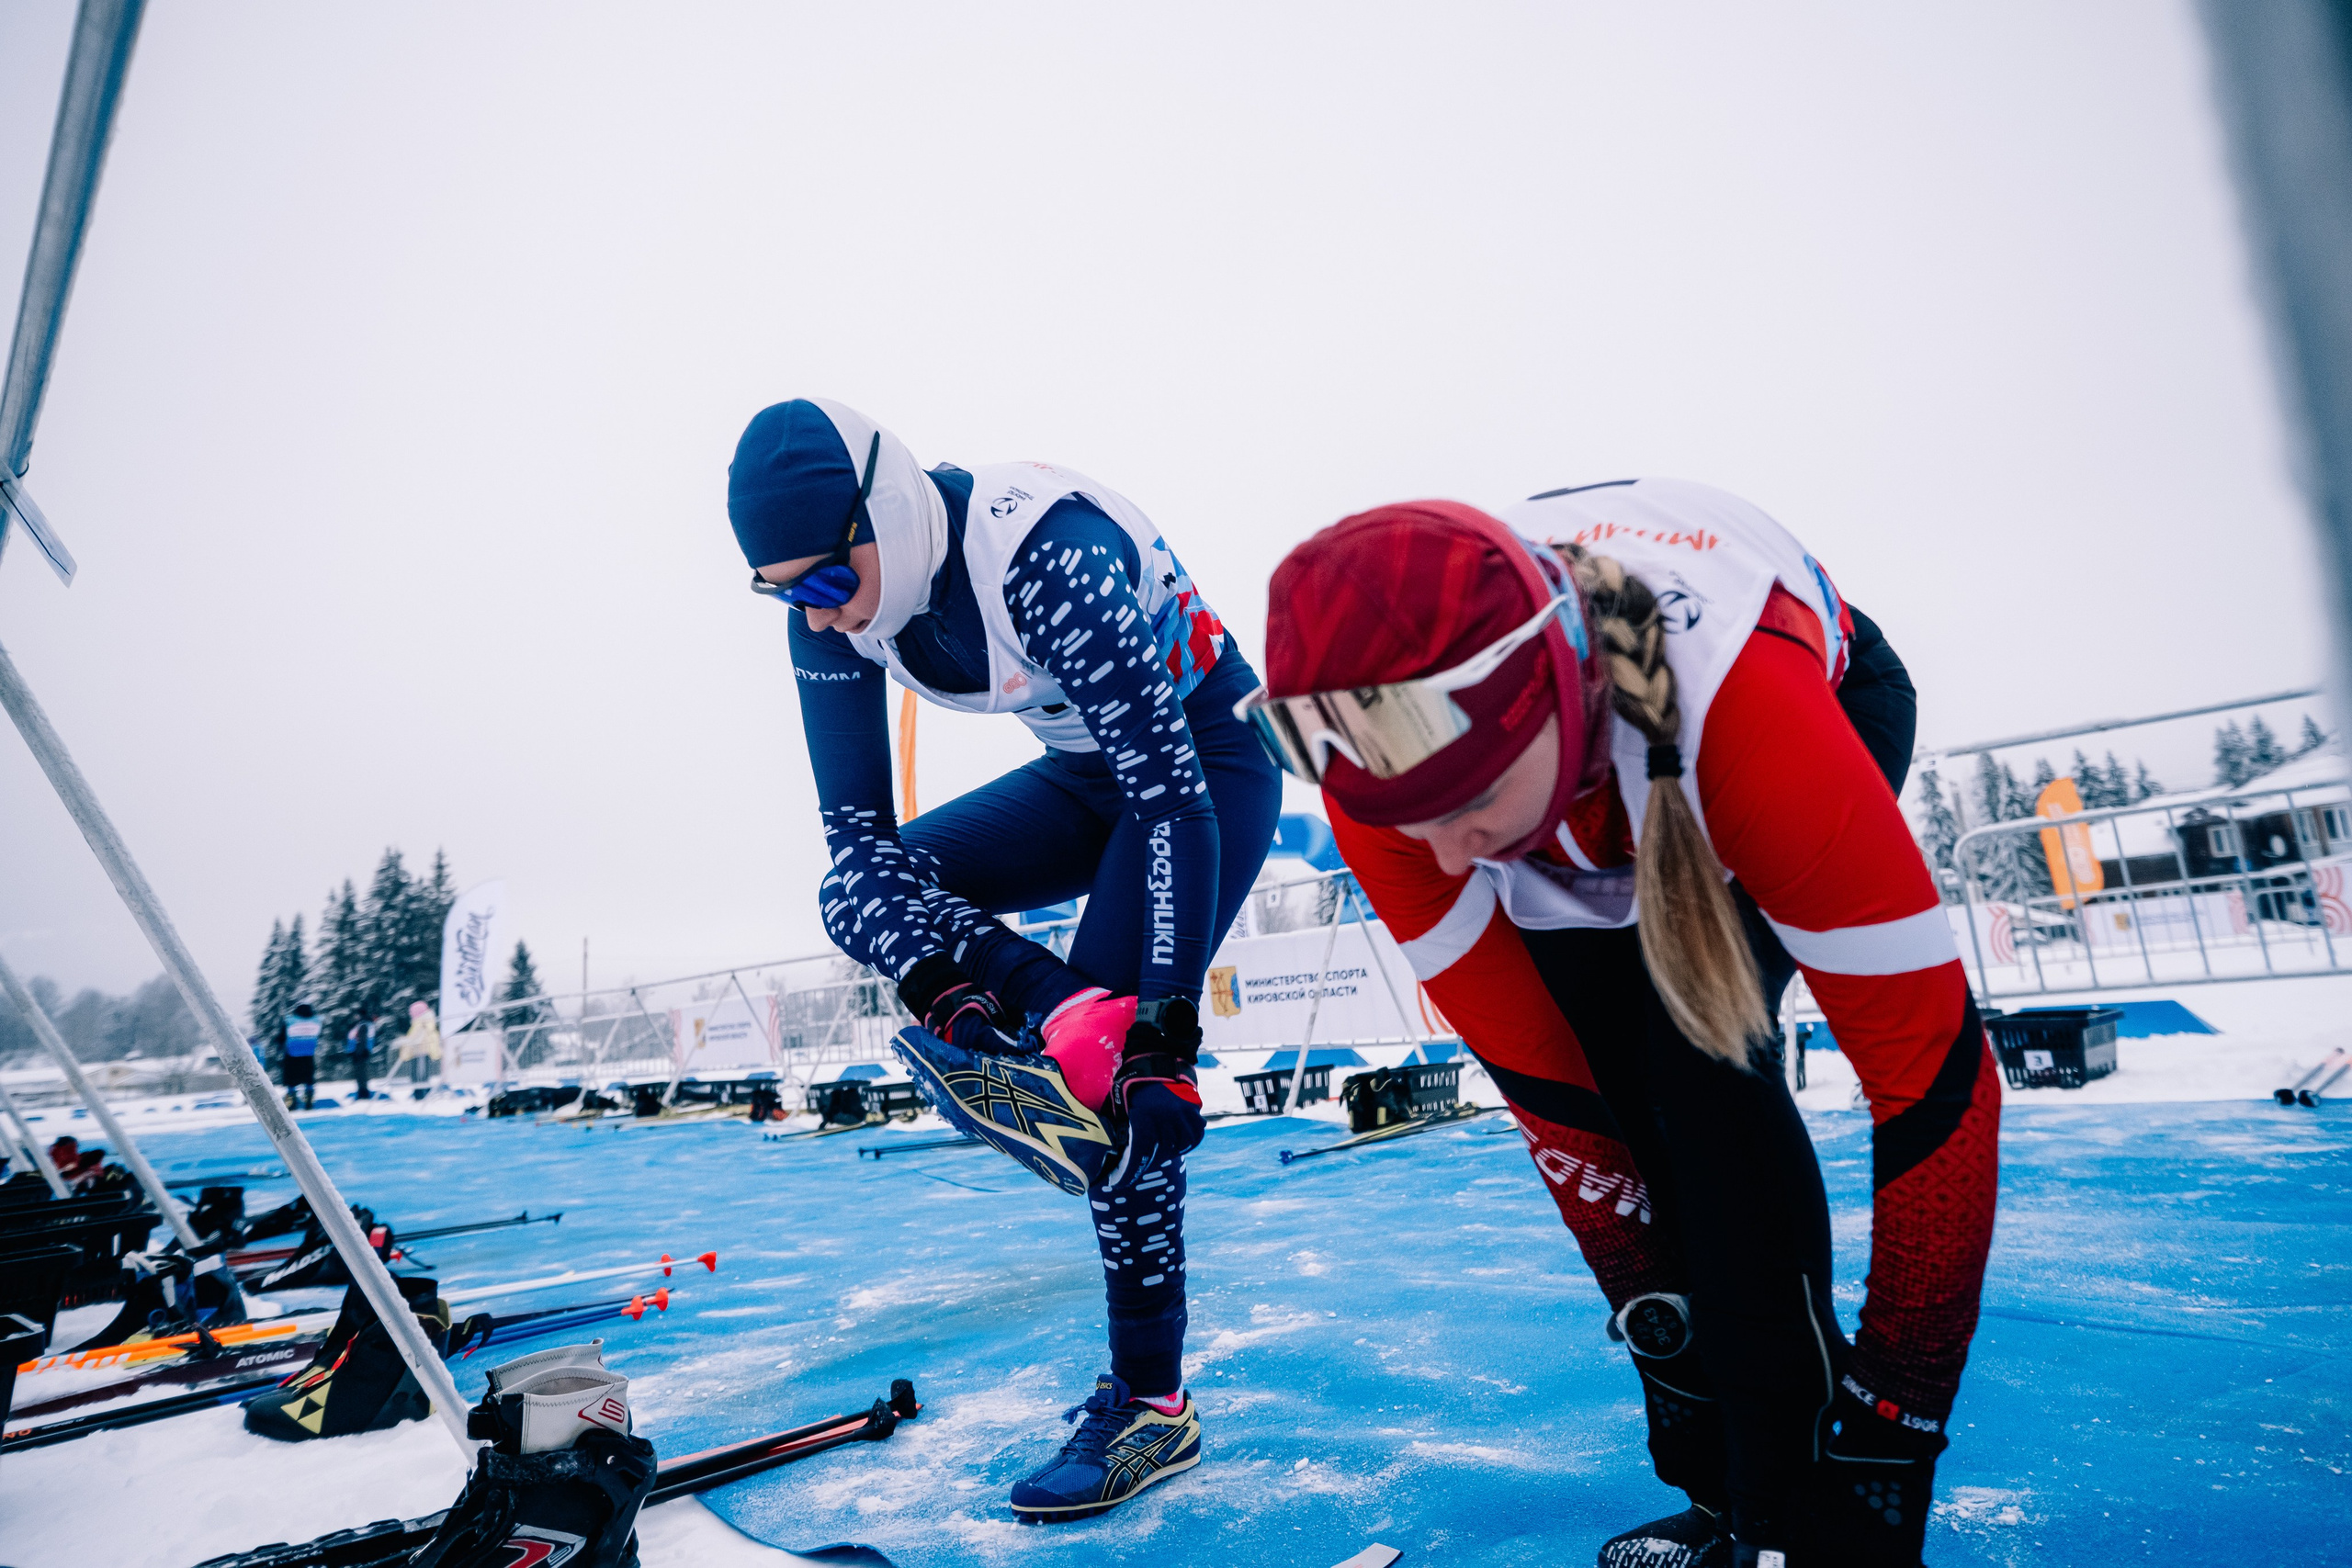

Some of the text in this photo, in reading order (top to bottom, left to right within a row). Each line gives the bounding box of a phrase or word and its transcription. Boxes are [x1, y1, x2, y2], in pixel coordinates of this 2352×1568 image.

[1325, 967, 1368, 982] СПОРТА
[1247, 986, 1359, 1004] КИРОВСКОЙ ОЛАСТИ
[235, 1348, 295, 1369] ATOMIC
